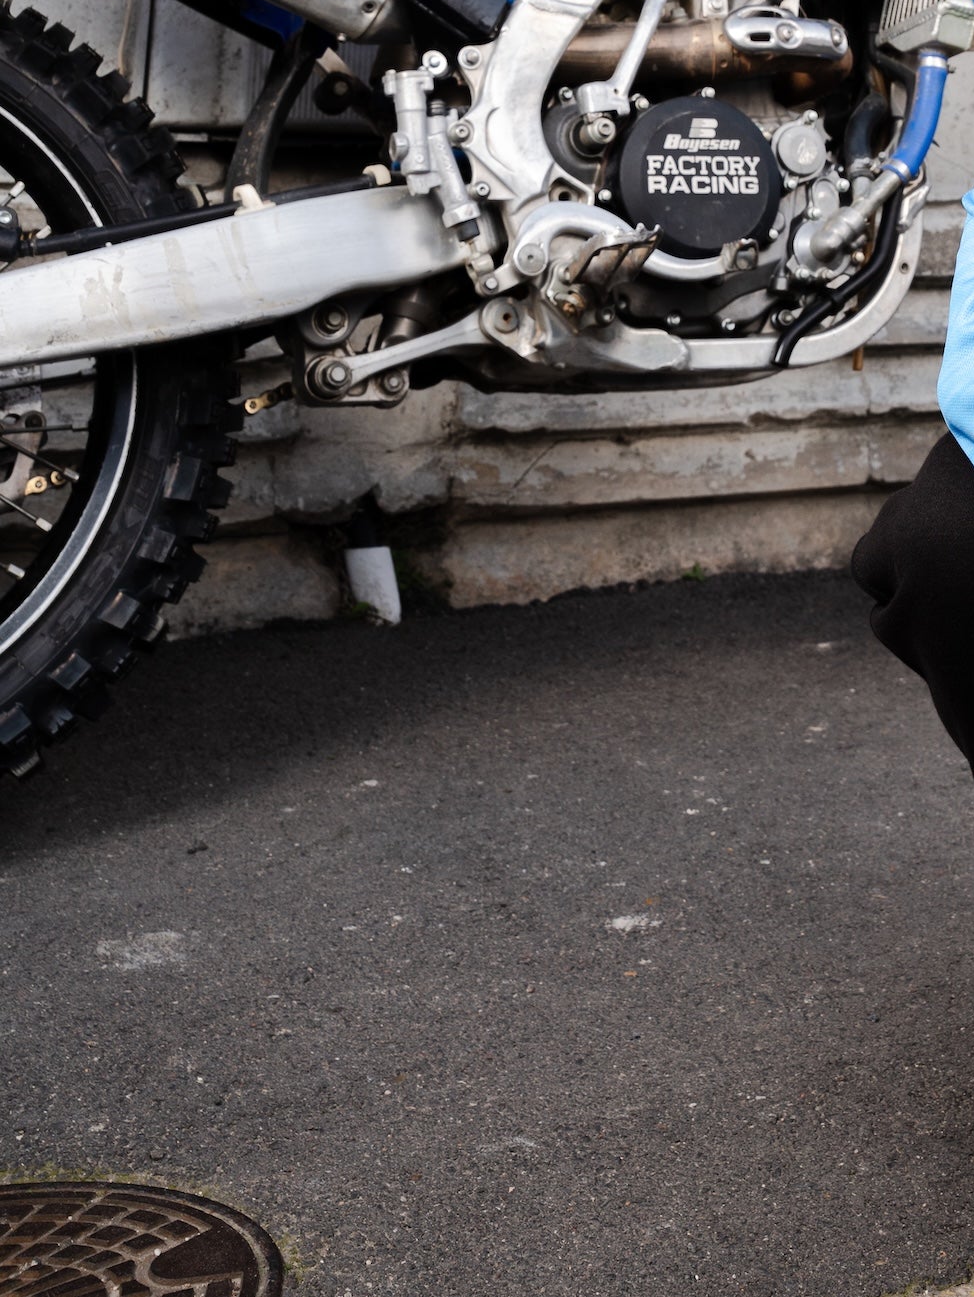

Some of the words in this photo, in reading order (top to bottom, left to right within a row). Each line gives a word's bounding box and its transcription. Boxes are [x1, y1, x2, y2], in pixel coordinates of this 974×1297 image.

[664, 134, 740, 152] Boyesen
[647, 155, 760, 175] FACTORY
[648, 176, 759, 194] RACING
